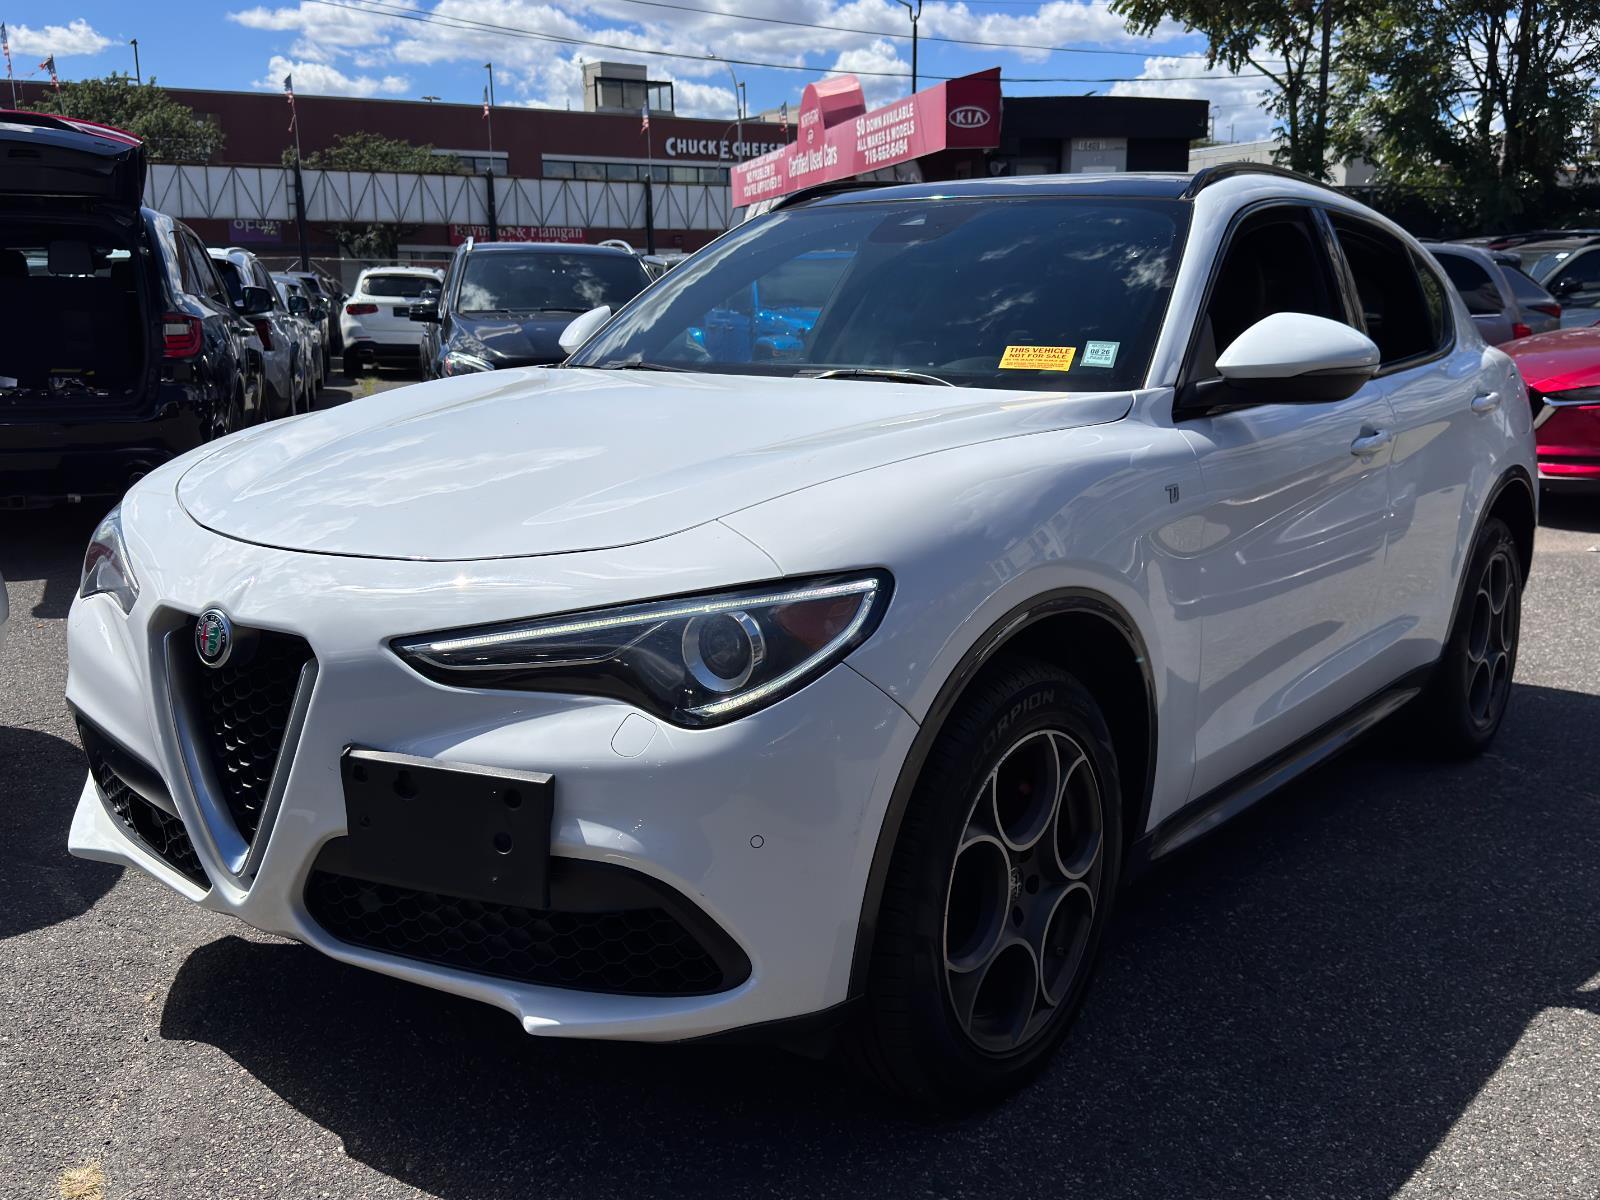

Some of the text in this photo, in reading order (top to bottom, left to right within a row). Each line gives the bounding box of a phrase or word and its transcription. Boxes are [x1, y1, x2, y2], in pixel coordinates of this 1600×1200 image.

[882, 103, 914, 128] AVAILABLE
[956, 111, 984, 124] KIA
[665, 137, 718, 156] CHUCK
[857, 137, 867, 152] ALL
[867, 131, 886, 149] MAKES
[891, 120, 915, 142] MODELS
[788, 150, 809, 178] Certified
[809, 146, 823, 172] Used
[823, 143, 838, 167] Cars
